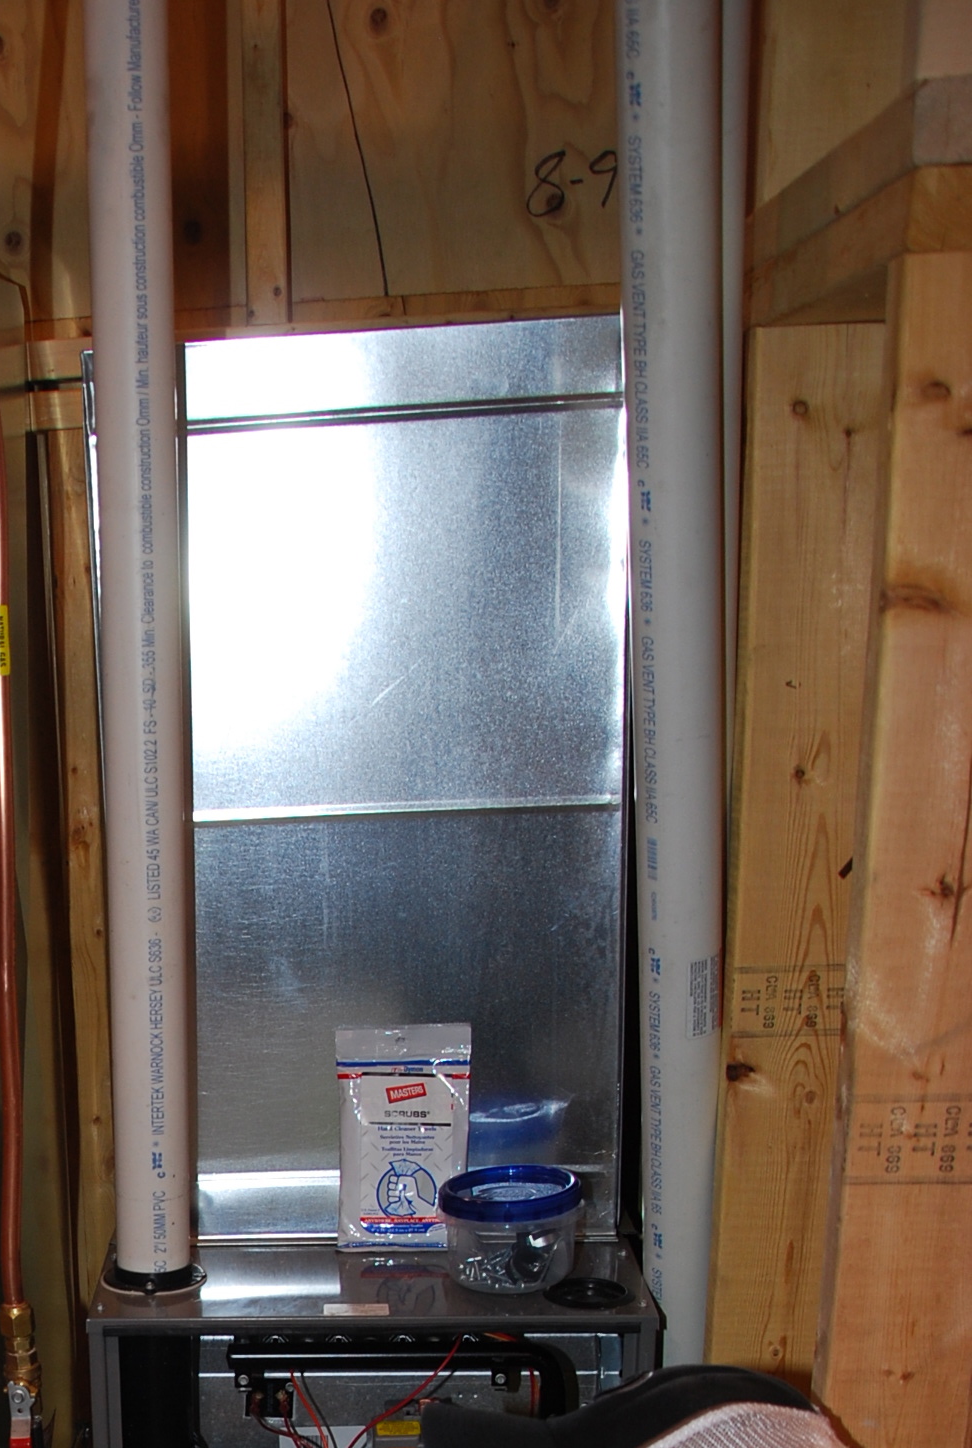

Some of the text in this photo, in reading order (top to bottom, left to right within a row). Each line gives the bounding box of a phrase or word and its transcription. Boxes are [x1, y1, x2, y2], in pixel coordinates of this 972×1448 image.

[126, 75, 143, 112] Follow
[628, 135, 644, 196] SYSTEM
[129, 155, 145, 222] combustible
[526, 148, 618, 218] 8-9
[629, 198, 644, 224] 636
[131, 224, 147, 291] construction
[630, 250, 645, 280] GAS
[133, 294, 148, 320] sous
[631, 282, 646, 318] VENT
[134, 323, 149, 364] hauteur
[632, 322, 647, 356] TYPE
[135, 367, 149, 389] Min.
[633, 360, 648, 378] BH
[634, 381, 649, 424] CLASS
[136, 429, 152, 491] construction
[635, 445, 650, 469] 65C
[137, 494, 154, 555] combustible
[139, 560, 153, 570] to
[638, 539, 652, 590] SYSTEM
[139, 572, 155, 624] Clearance
[639, 591, 653, 612] 636
[140, 627, 155, 648] Min.
[640, 636, 655, 661] GAS
[642, 664, 655, 695] VENT
[643, 697, 656, 727] TYPE
[142, 720, 157, 734] FS
[643, 729, 656, 745] BH
[644, 747, 658, 785] CLASS
[144, 776, 158, 798] ULC
[645, 802, 659, 824] 65C
[145, 848, 160, 861] 45
[146, 863, 162, 900] LISTED
[147, 938, 162, 963] S636
[147, 965, 163, 987] ULC
[148, 989, 164, 1030] HERSEY
[648, 991, 661, 1032] SYSTEM
[649, 1033, 661, 1053] 636
[149, 1031, 165, 1085] WARNOCK
[649, 1065, 662, 1087] GAS
[390, 1084, 424, 1100] MASTERS
[650, 1088, 662, 1115] VENT
[150, 1086, 166, 1136] INTERTEK
[384, 1110, 428, 1118] SCRUBS
[650, 1116, 662, 1142] TYPE
[912, 1123, 938, 1156] HT
[650, 1142, 662, 1156] BH
[650, 1158, 662, 1190] CLASS
[151, 1190, 166, 1211] PVC
